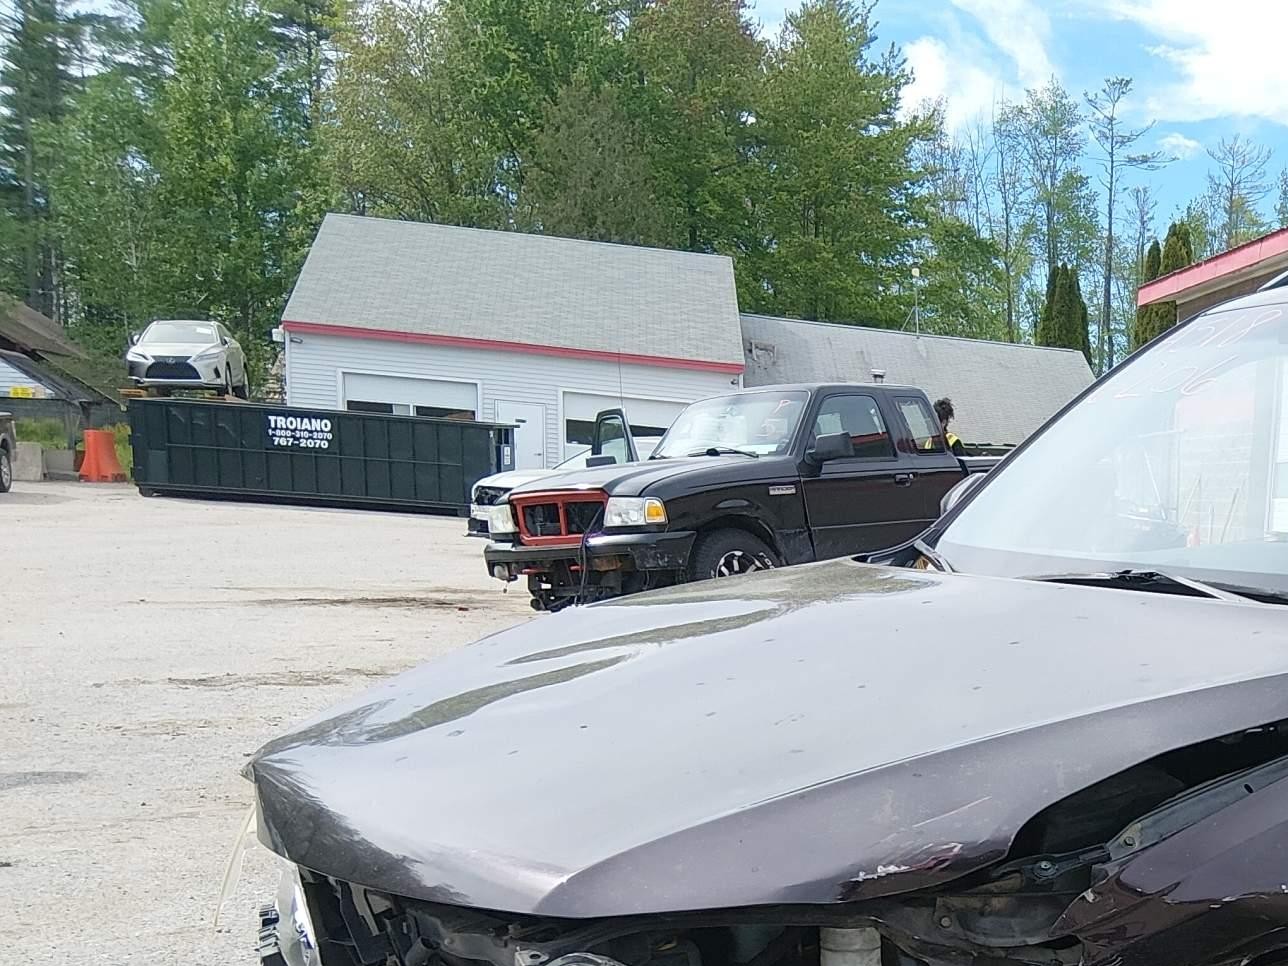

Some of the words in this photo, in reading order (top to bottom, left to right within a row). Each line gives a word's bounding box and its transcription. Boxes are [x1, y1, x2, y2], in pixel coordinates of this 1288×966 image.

[268, 415, 332, 432] TROIANO
[268, 429, 333, 440] 1-800-310-2070
[272, 437, 329, 449] 767-2070
